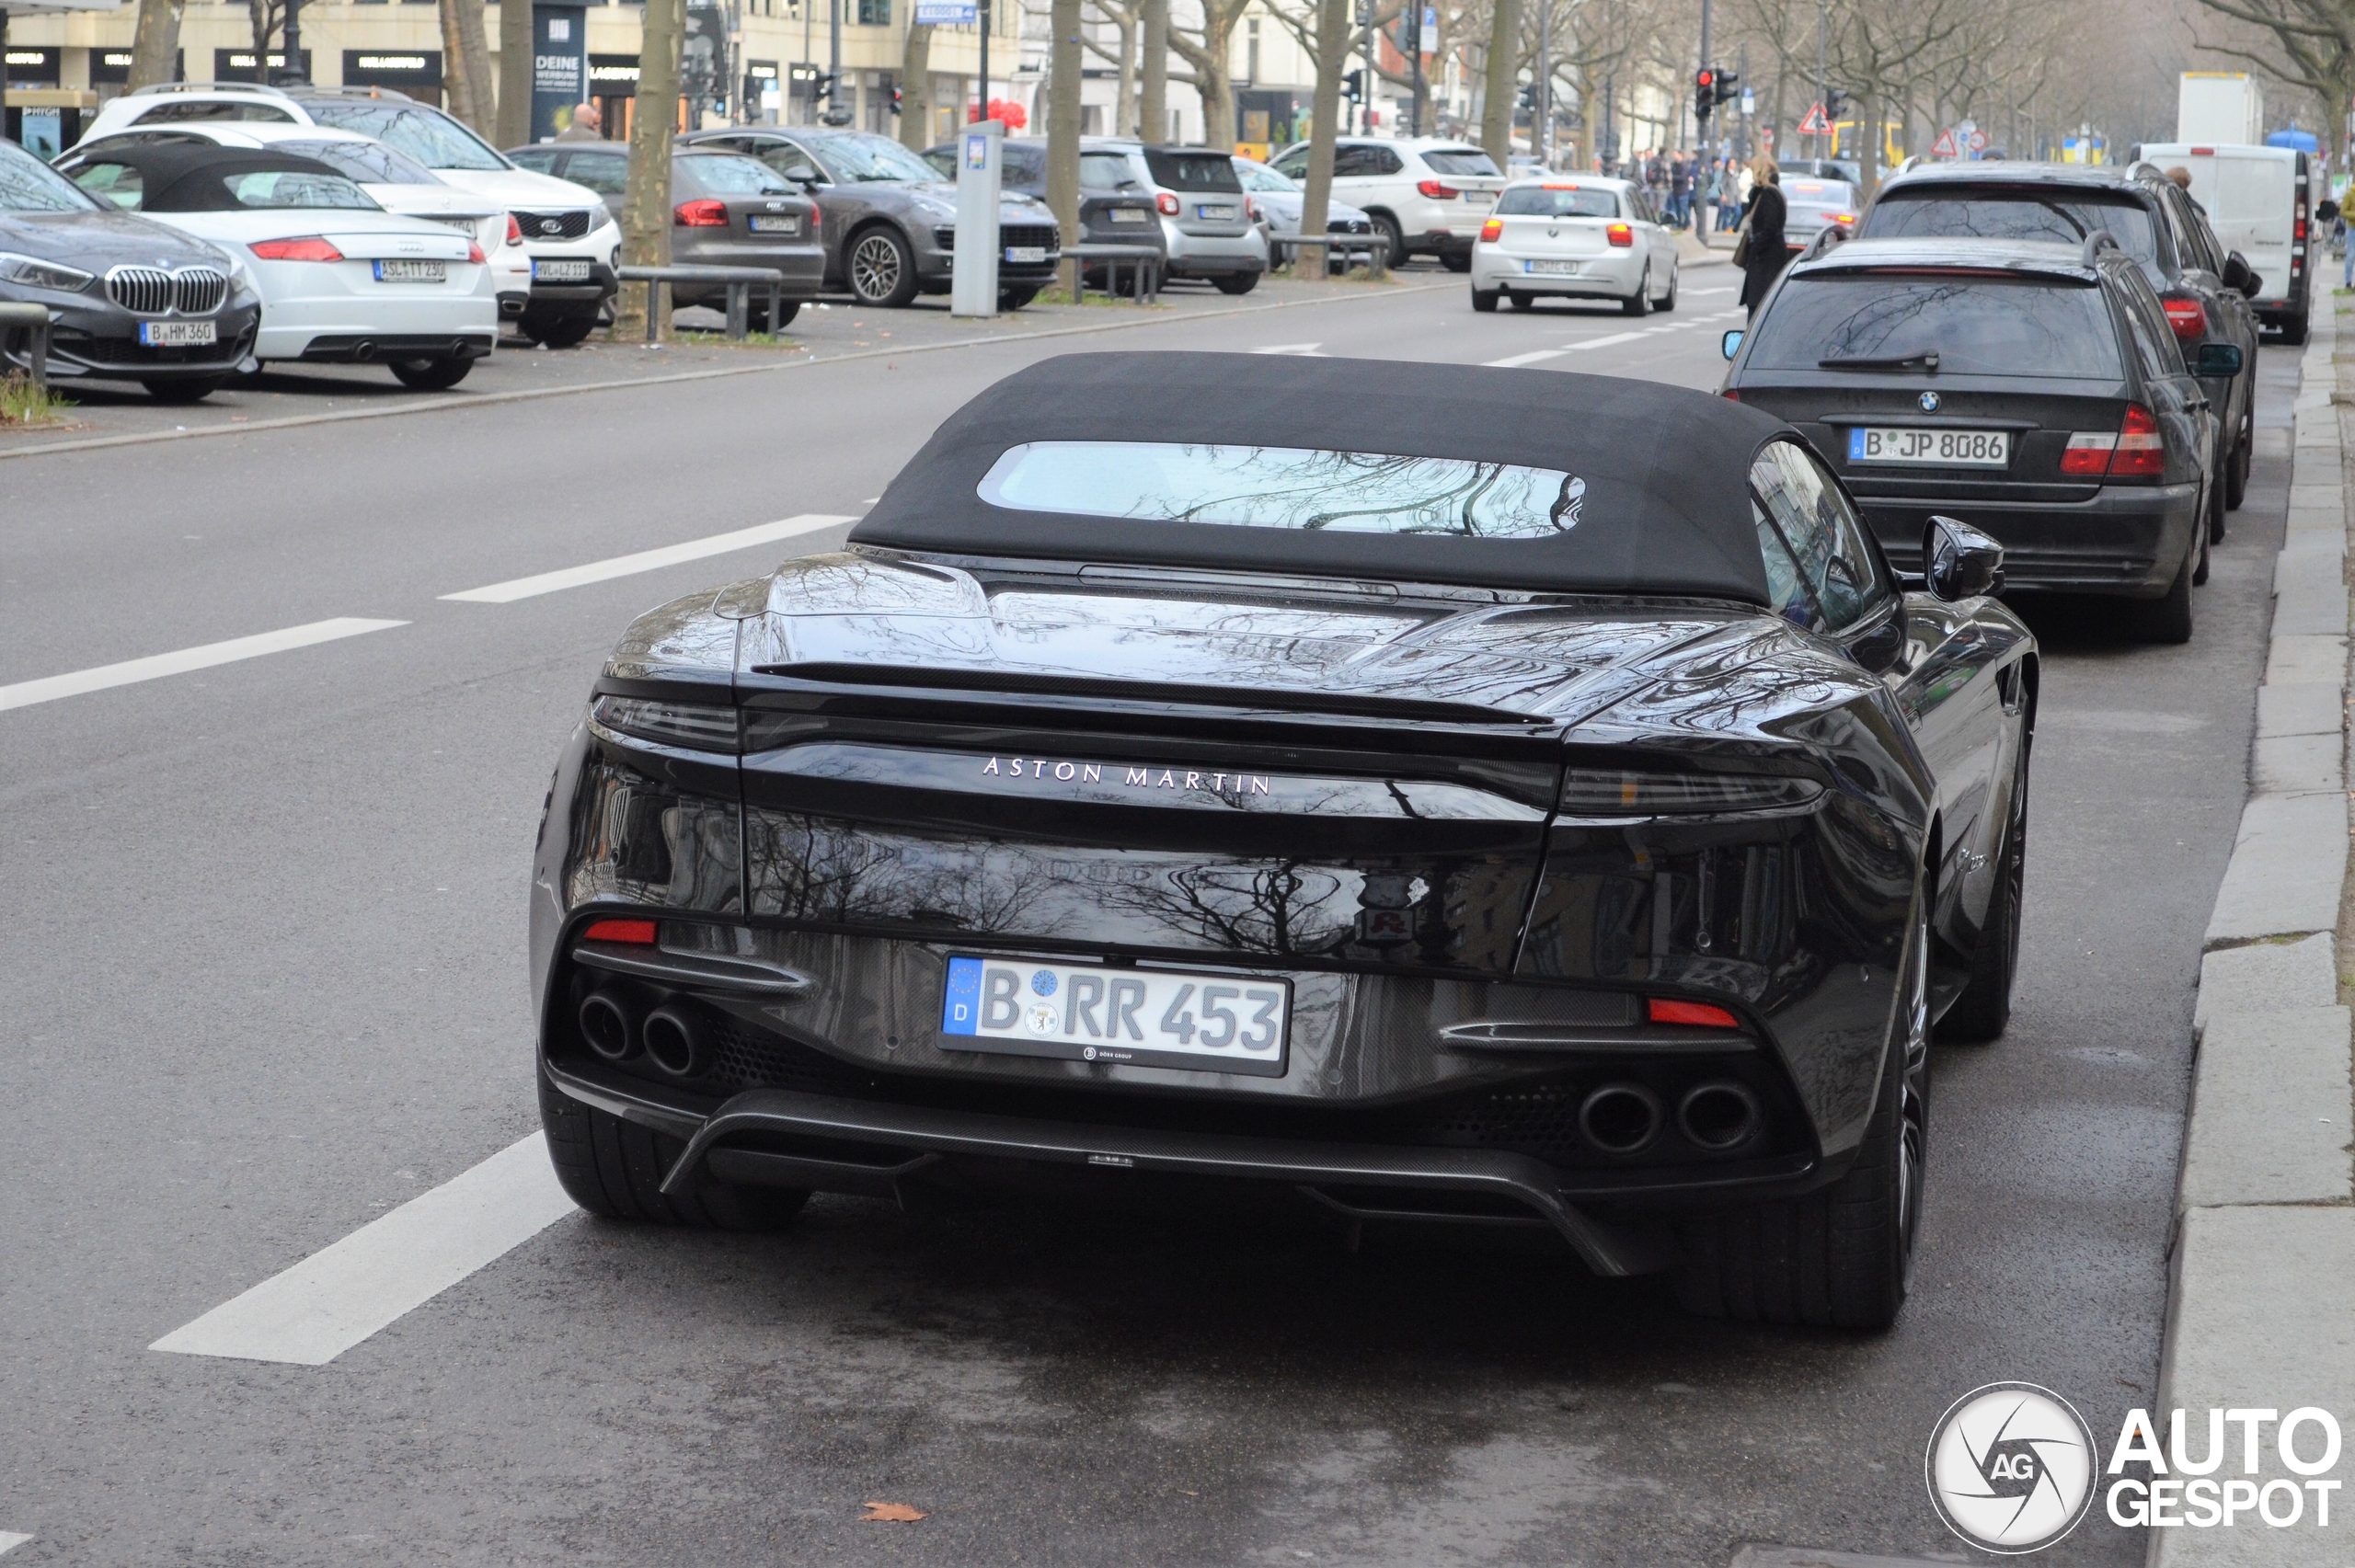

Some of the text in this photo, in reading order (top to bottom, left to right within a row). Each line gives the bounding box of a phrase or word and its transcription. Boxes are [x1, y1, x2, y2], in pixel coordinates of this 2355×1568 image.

[535, 55, 579, 71] DEINE
[383, 261, 402, 277] ASL
[410, 262, 421, 276] TT
[559, 264, 570, 276] LZ
[573, 264, 587, 276] 111
[153, 324, 211, 340] B HM 360
[1854, 431, 2004, 460] D B JP 8086
[982, 756, 1270, 796] ASTON MARTIN
[954, 967, 1281, 1051] D B RR 453
